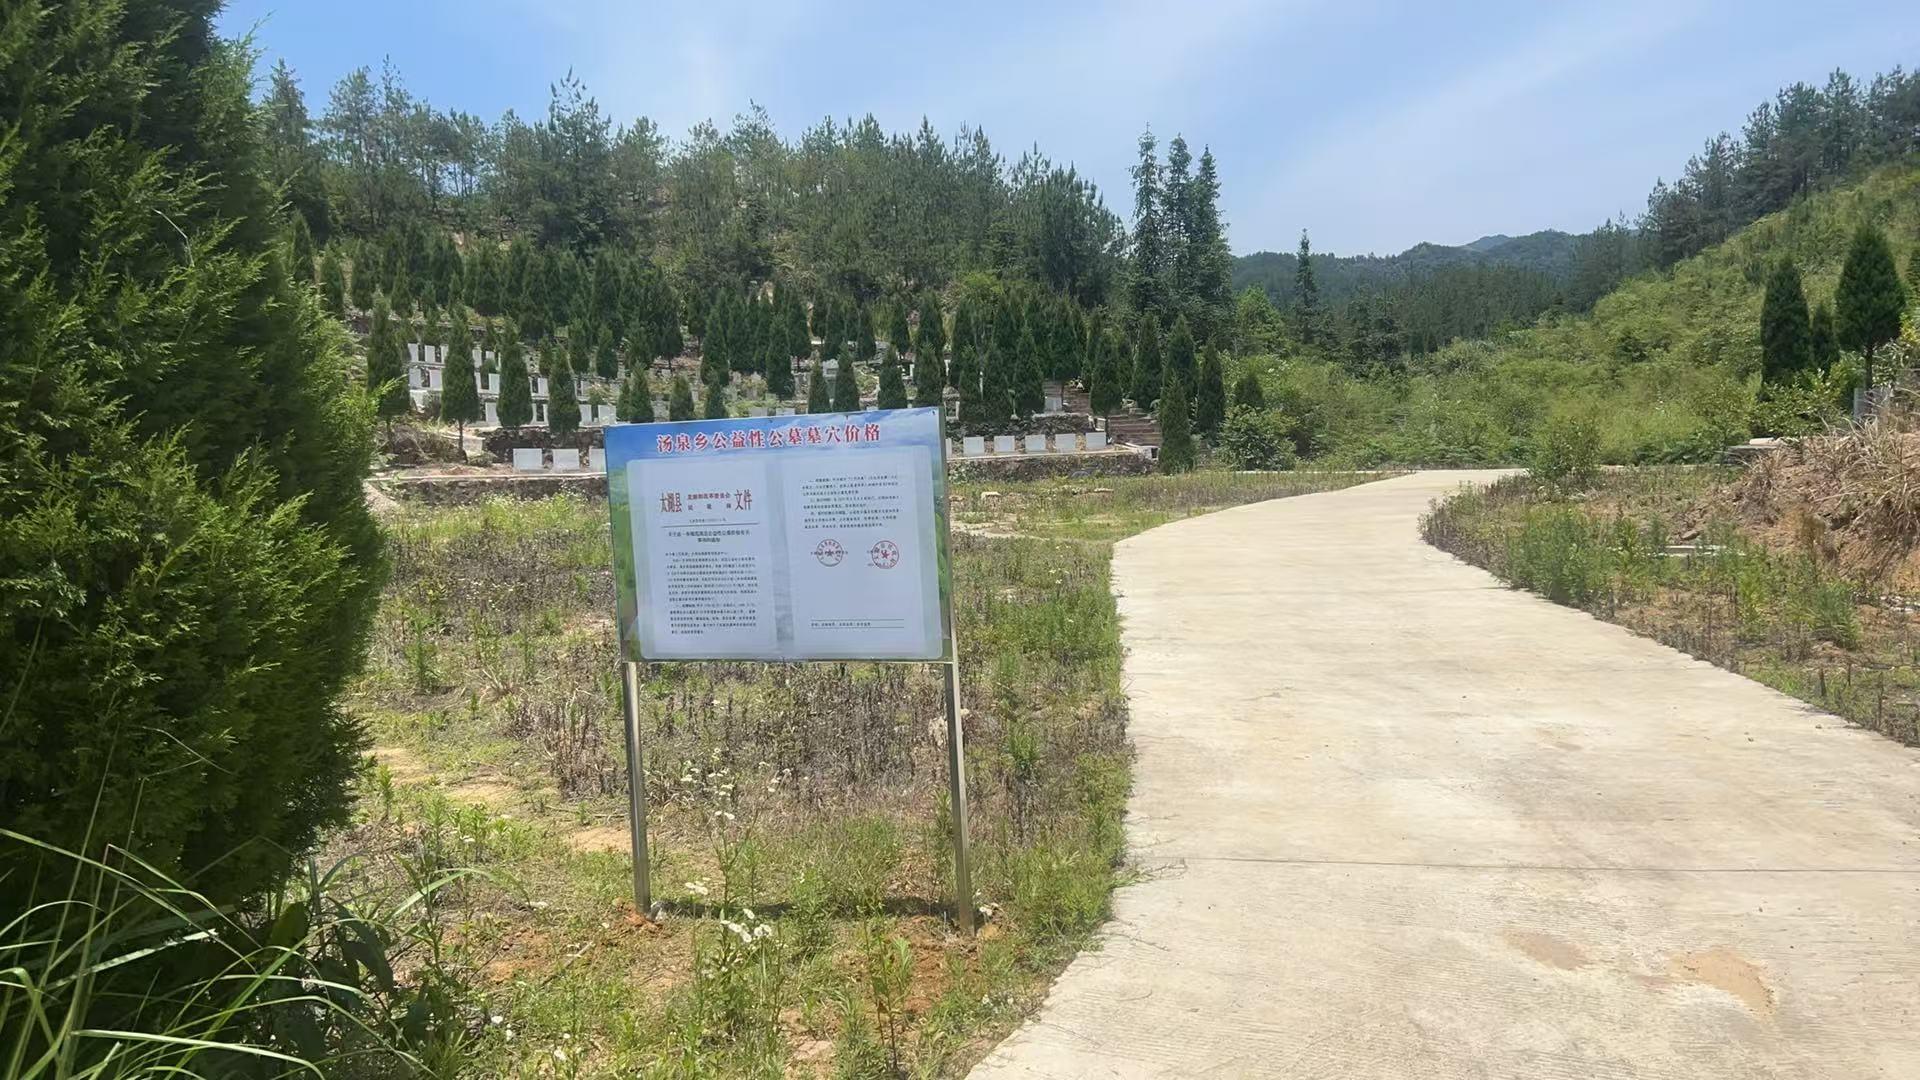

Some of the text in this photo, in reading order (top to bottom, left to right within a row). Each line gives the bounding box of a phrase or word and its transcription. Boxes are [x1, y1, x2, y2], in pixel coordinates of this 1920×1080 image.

[657, 423, 881, 453] 汤泉乡公益性公墓墓穴价格
[734, 489, 752, 511] 文件
